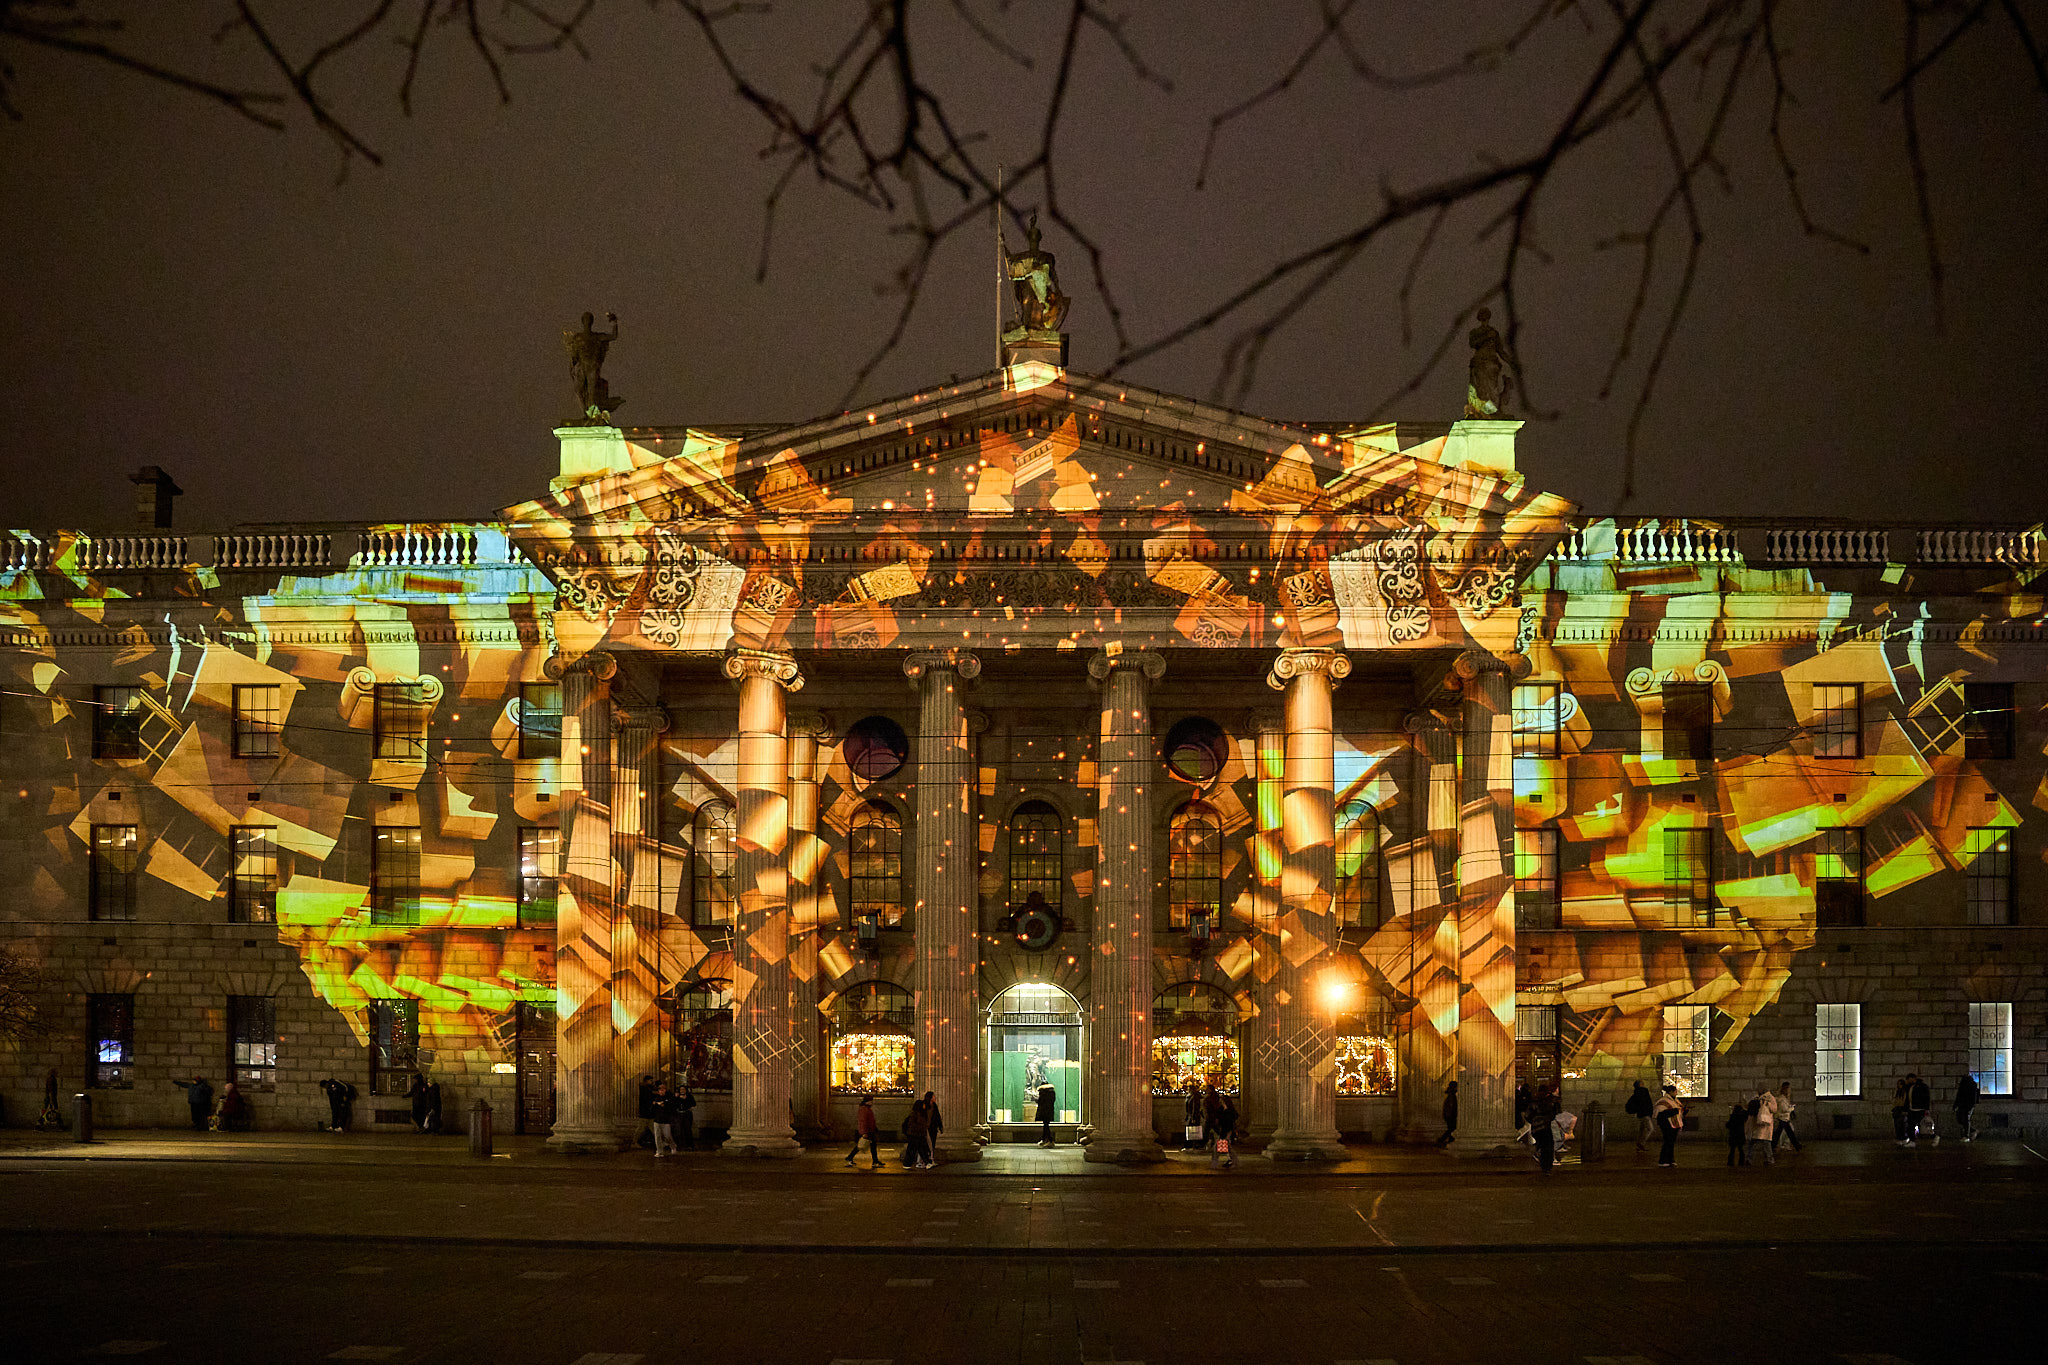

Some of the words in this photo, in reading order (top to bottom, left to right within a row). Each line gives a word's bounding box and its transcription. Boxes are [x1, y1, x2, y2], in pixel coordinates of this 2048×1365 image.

[1665, 1032, 1696, 1044] Caf
[1820, 1030, 1854, 1043] Shop
[1972, 1029, 2006, 1042] Shop
